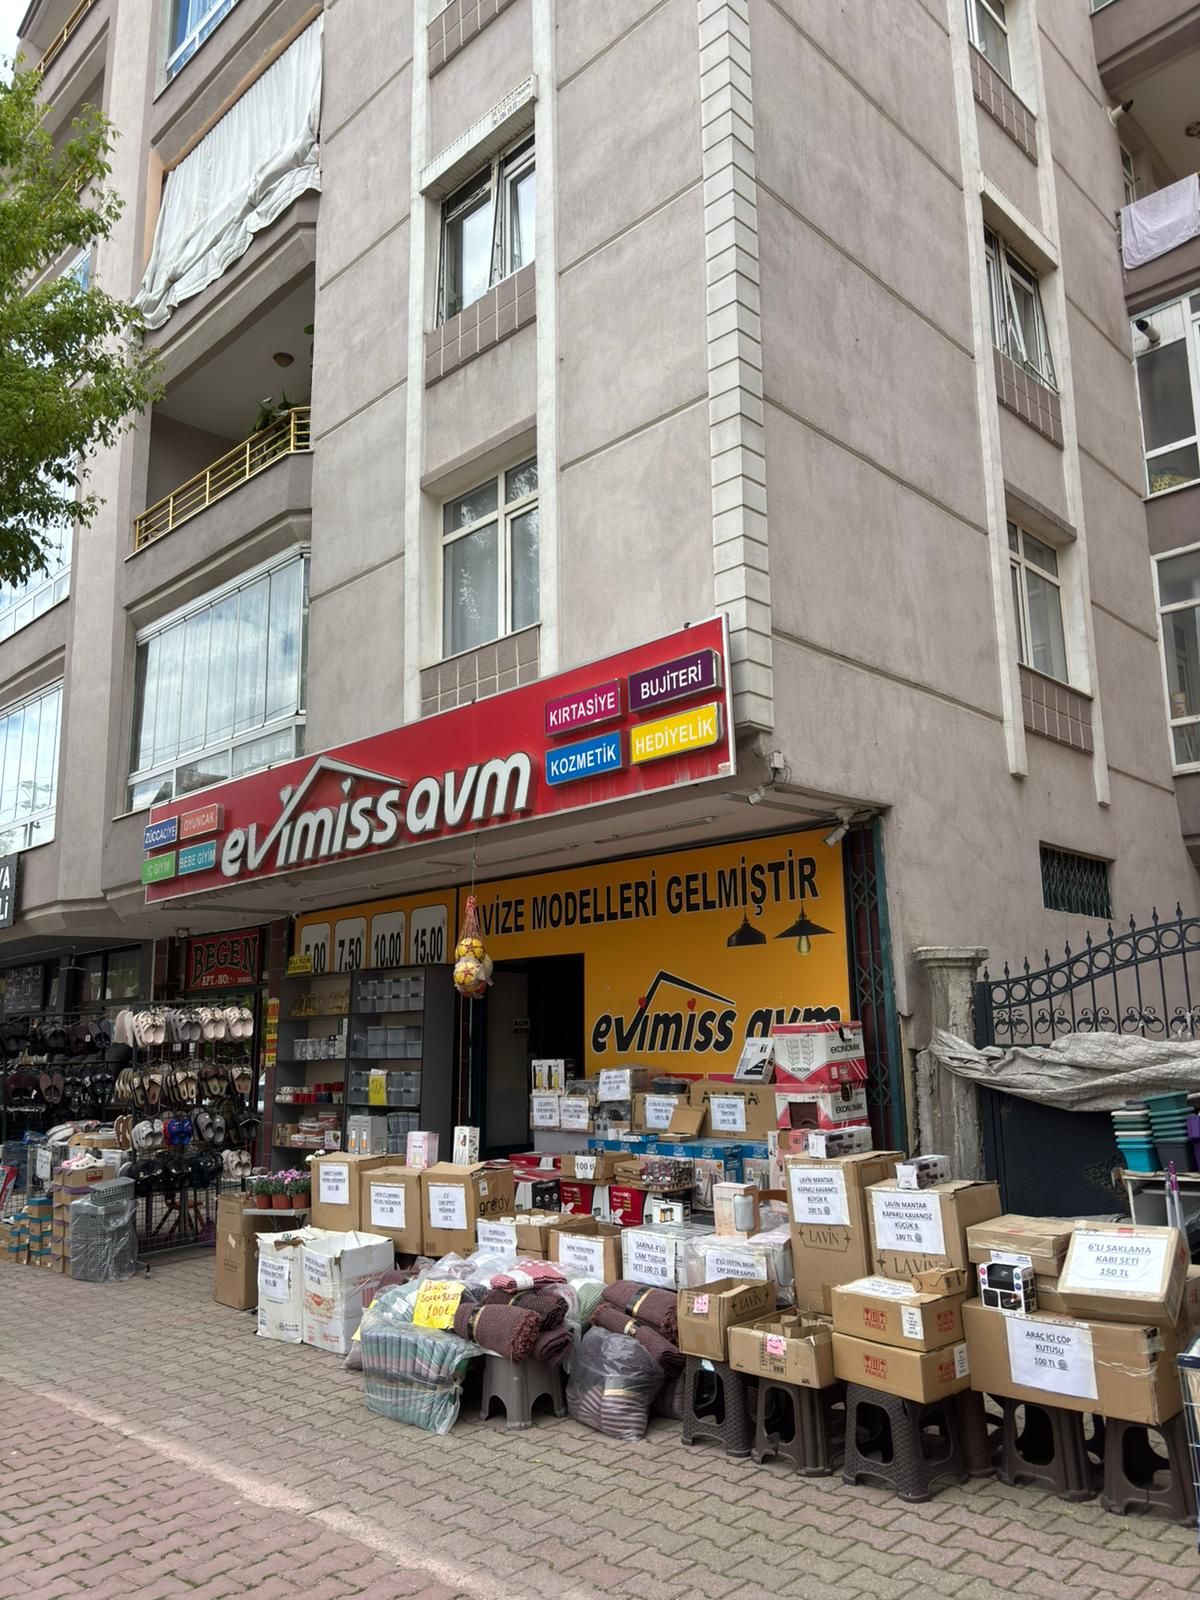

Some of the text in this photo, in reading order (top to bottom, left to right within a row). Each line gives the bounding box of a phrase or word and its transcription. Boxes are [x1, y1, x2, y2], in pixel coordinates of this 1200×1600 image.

[640, 660, 702, 700] BUJİTERİ
[549, 692, 616, 727] KIRTASİYE
[635, 716, 714, 755] HEDİYELİK
[550, 743, 617, 777] KOZMETİK
[183, 811, 215, 832] OYUNCAK
[221, 751, 532, 877] evimiss avm
[180, 854, 197, 869] BEBE
[531, 869, 657, 931] MODELLERİ
[665, 848, 820, 916] GELMİŞTİR
[374, 931, 402, 967] 10.00
[414, 925, 444, 964] 15.00
[338, 936, 363, 972] 7.50
[590, 985, 739, 1055] evimiss
[576, 1162, 589, 1171] 100
[901, 1201, 927, 1210] MANTAR
[904, 1211, 933, 1222] KAVANOZ
[1105, 1243, 1152, 1255] SAKLAMA
[1095, 1255, 1140, 1266] KABI SETİ
[1100, 1267, 1129, 1278] 150 TL
[864, 1320, 888, 1332] FRAGILE
[1025, 1330, 1045, 1342] ARAÇ
[1056, 1333, 1072, 1345] ÇÖP
[1034, 1343, 1065, 1356] KUTUSU
[1033, 1356, 1057, 1368] 100 TL
[864, 1368, 888, 1380] FRAGILE
